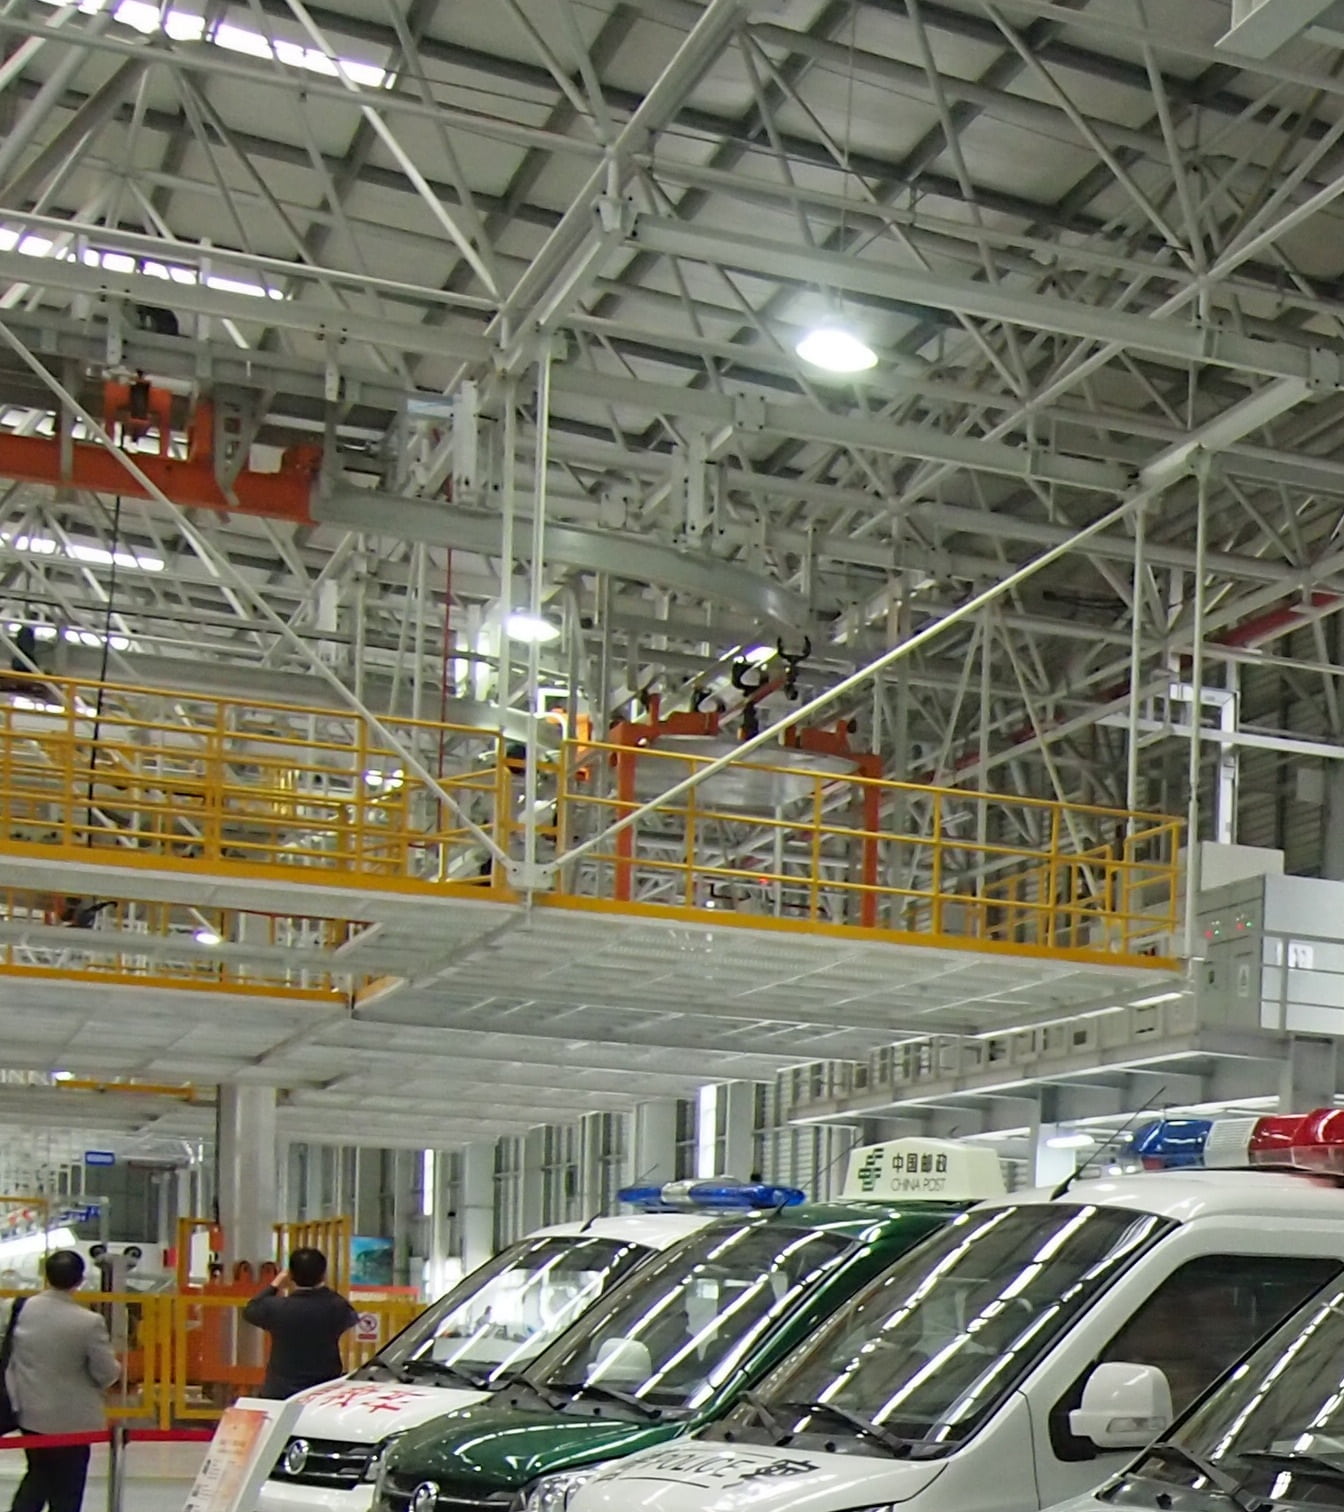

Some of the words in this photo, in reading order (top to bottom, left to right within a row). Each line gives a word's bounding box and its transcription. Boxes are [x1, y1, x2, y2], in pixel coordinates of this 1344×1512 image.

[892, 1152, 947, 1173] 中国邮政
[891, 1178, 921, 1192] CHINA
[923, 1178, 946, 1192] POST
[643, 1453, 755, 1478] POLICE
